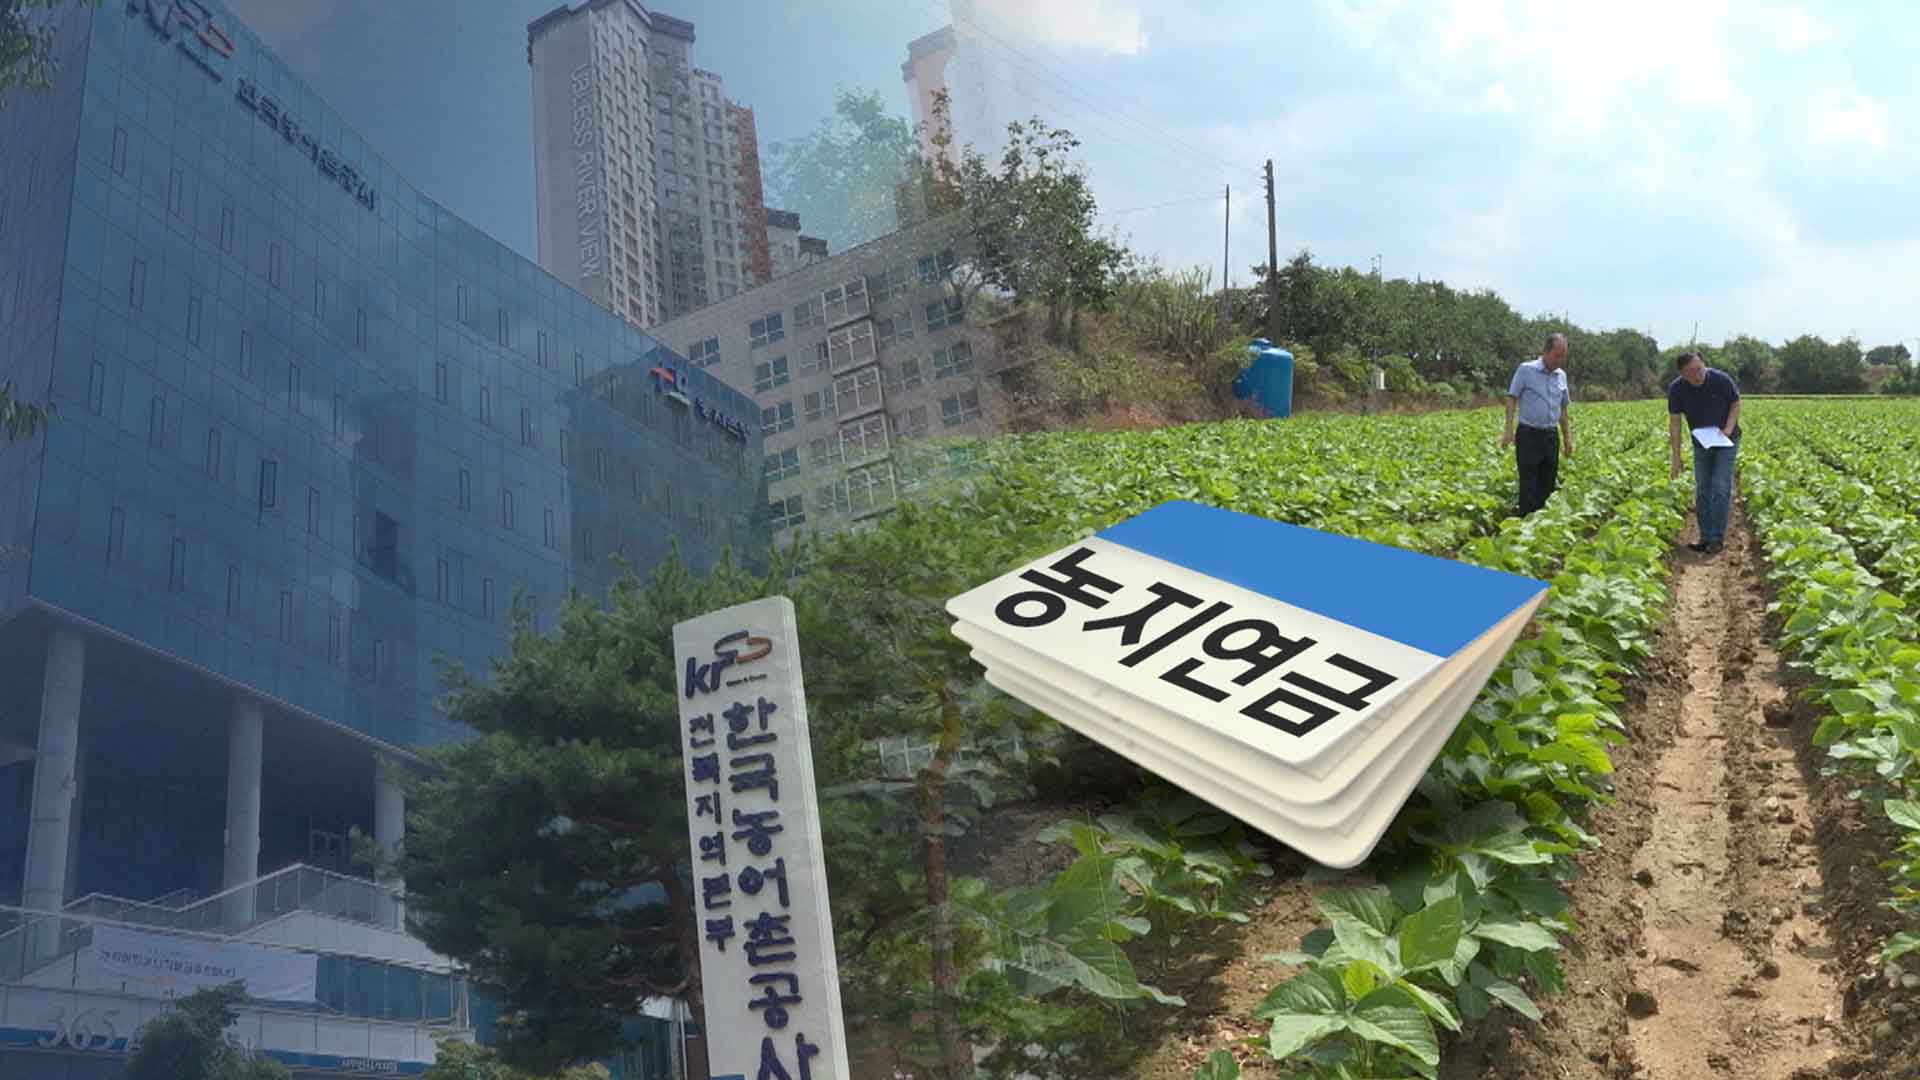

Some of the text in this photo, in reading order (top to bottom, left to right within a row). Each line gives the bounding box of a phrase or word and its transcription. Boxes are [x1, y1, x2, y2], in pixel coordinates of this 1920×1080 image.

[576, 150, 597, 218] RIVER
[580, 217, 601, 277] VIEW
[689, 713, 735, 951] 전북지역본부
[722, 697, 820, 1080] 한국농어촌공사
[39, 1003, 121, 1050] 365
